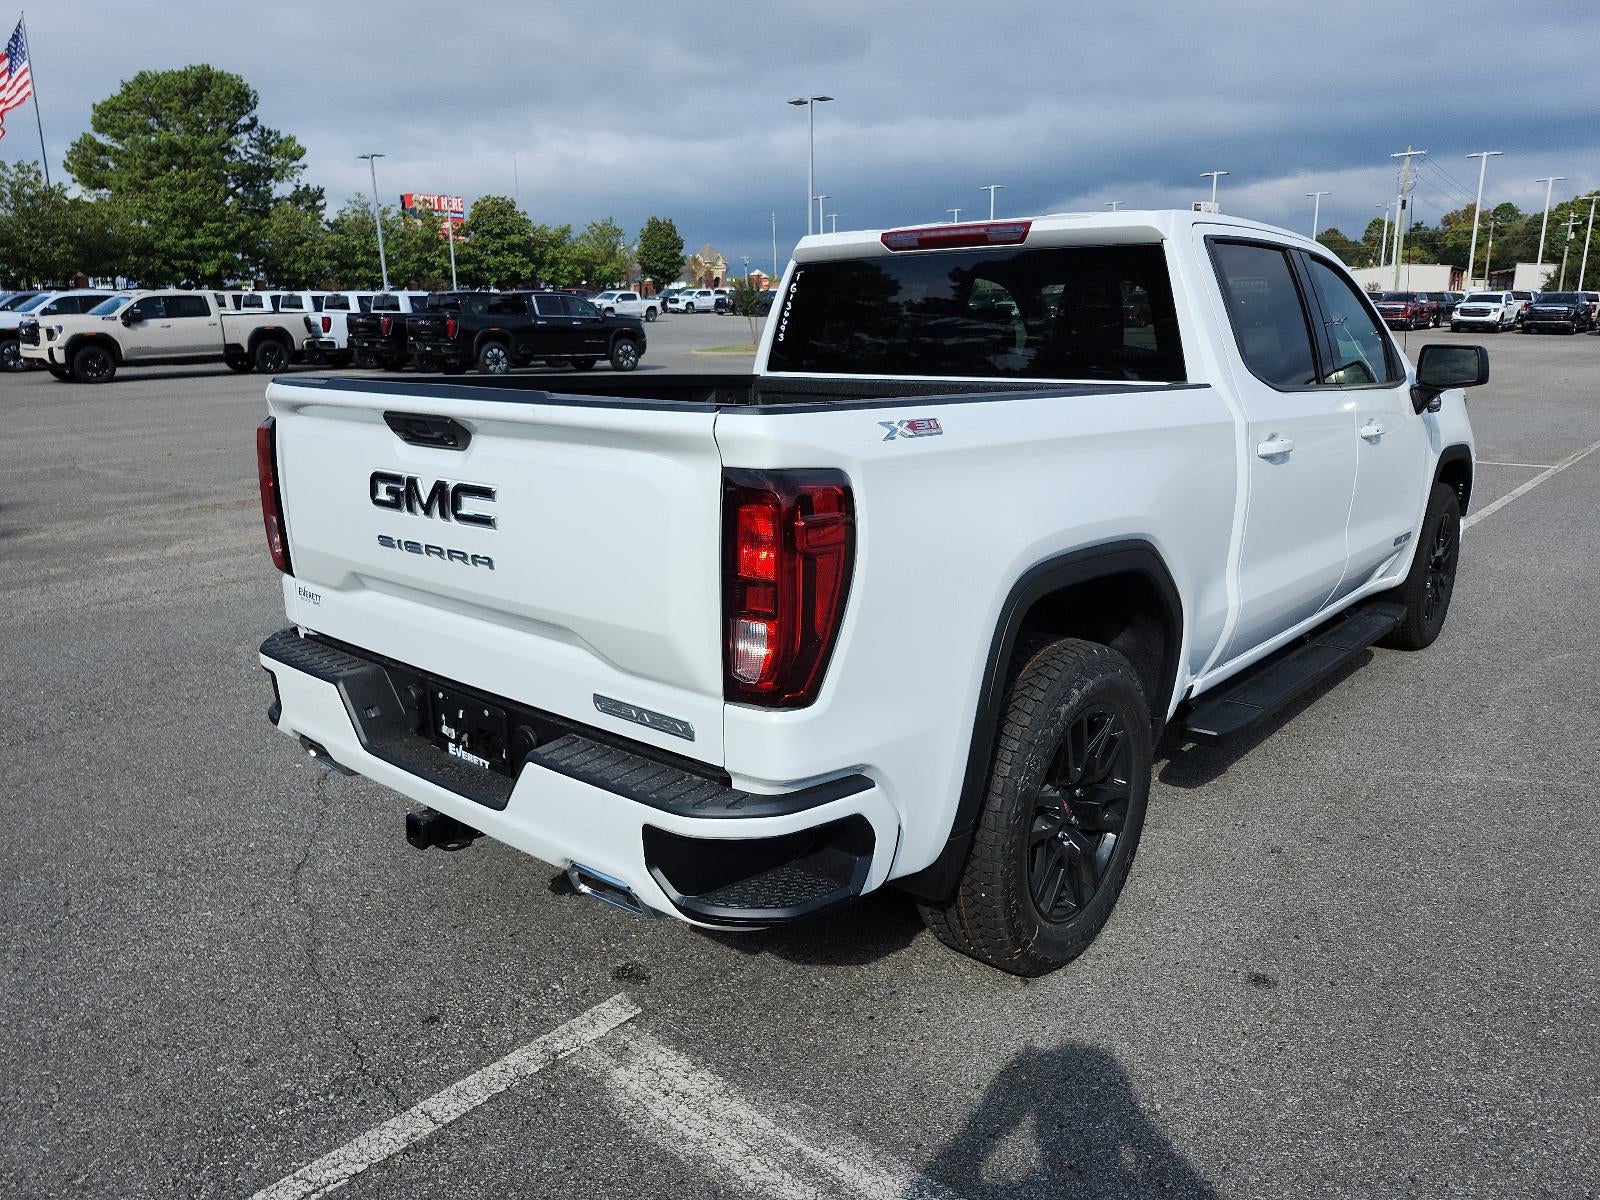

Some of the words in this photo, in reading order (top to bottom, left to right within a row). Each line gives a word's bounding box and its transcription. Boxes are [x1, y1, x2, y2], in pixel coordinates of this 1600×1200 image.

[441, 196, 464, 212] HERE
[369, 470, 498, 530] GMC
[377, 534, 496, 570] SIERRA
[448, 741, 490, 769] EVERETT
